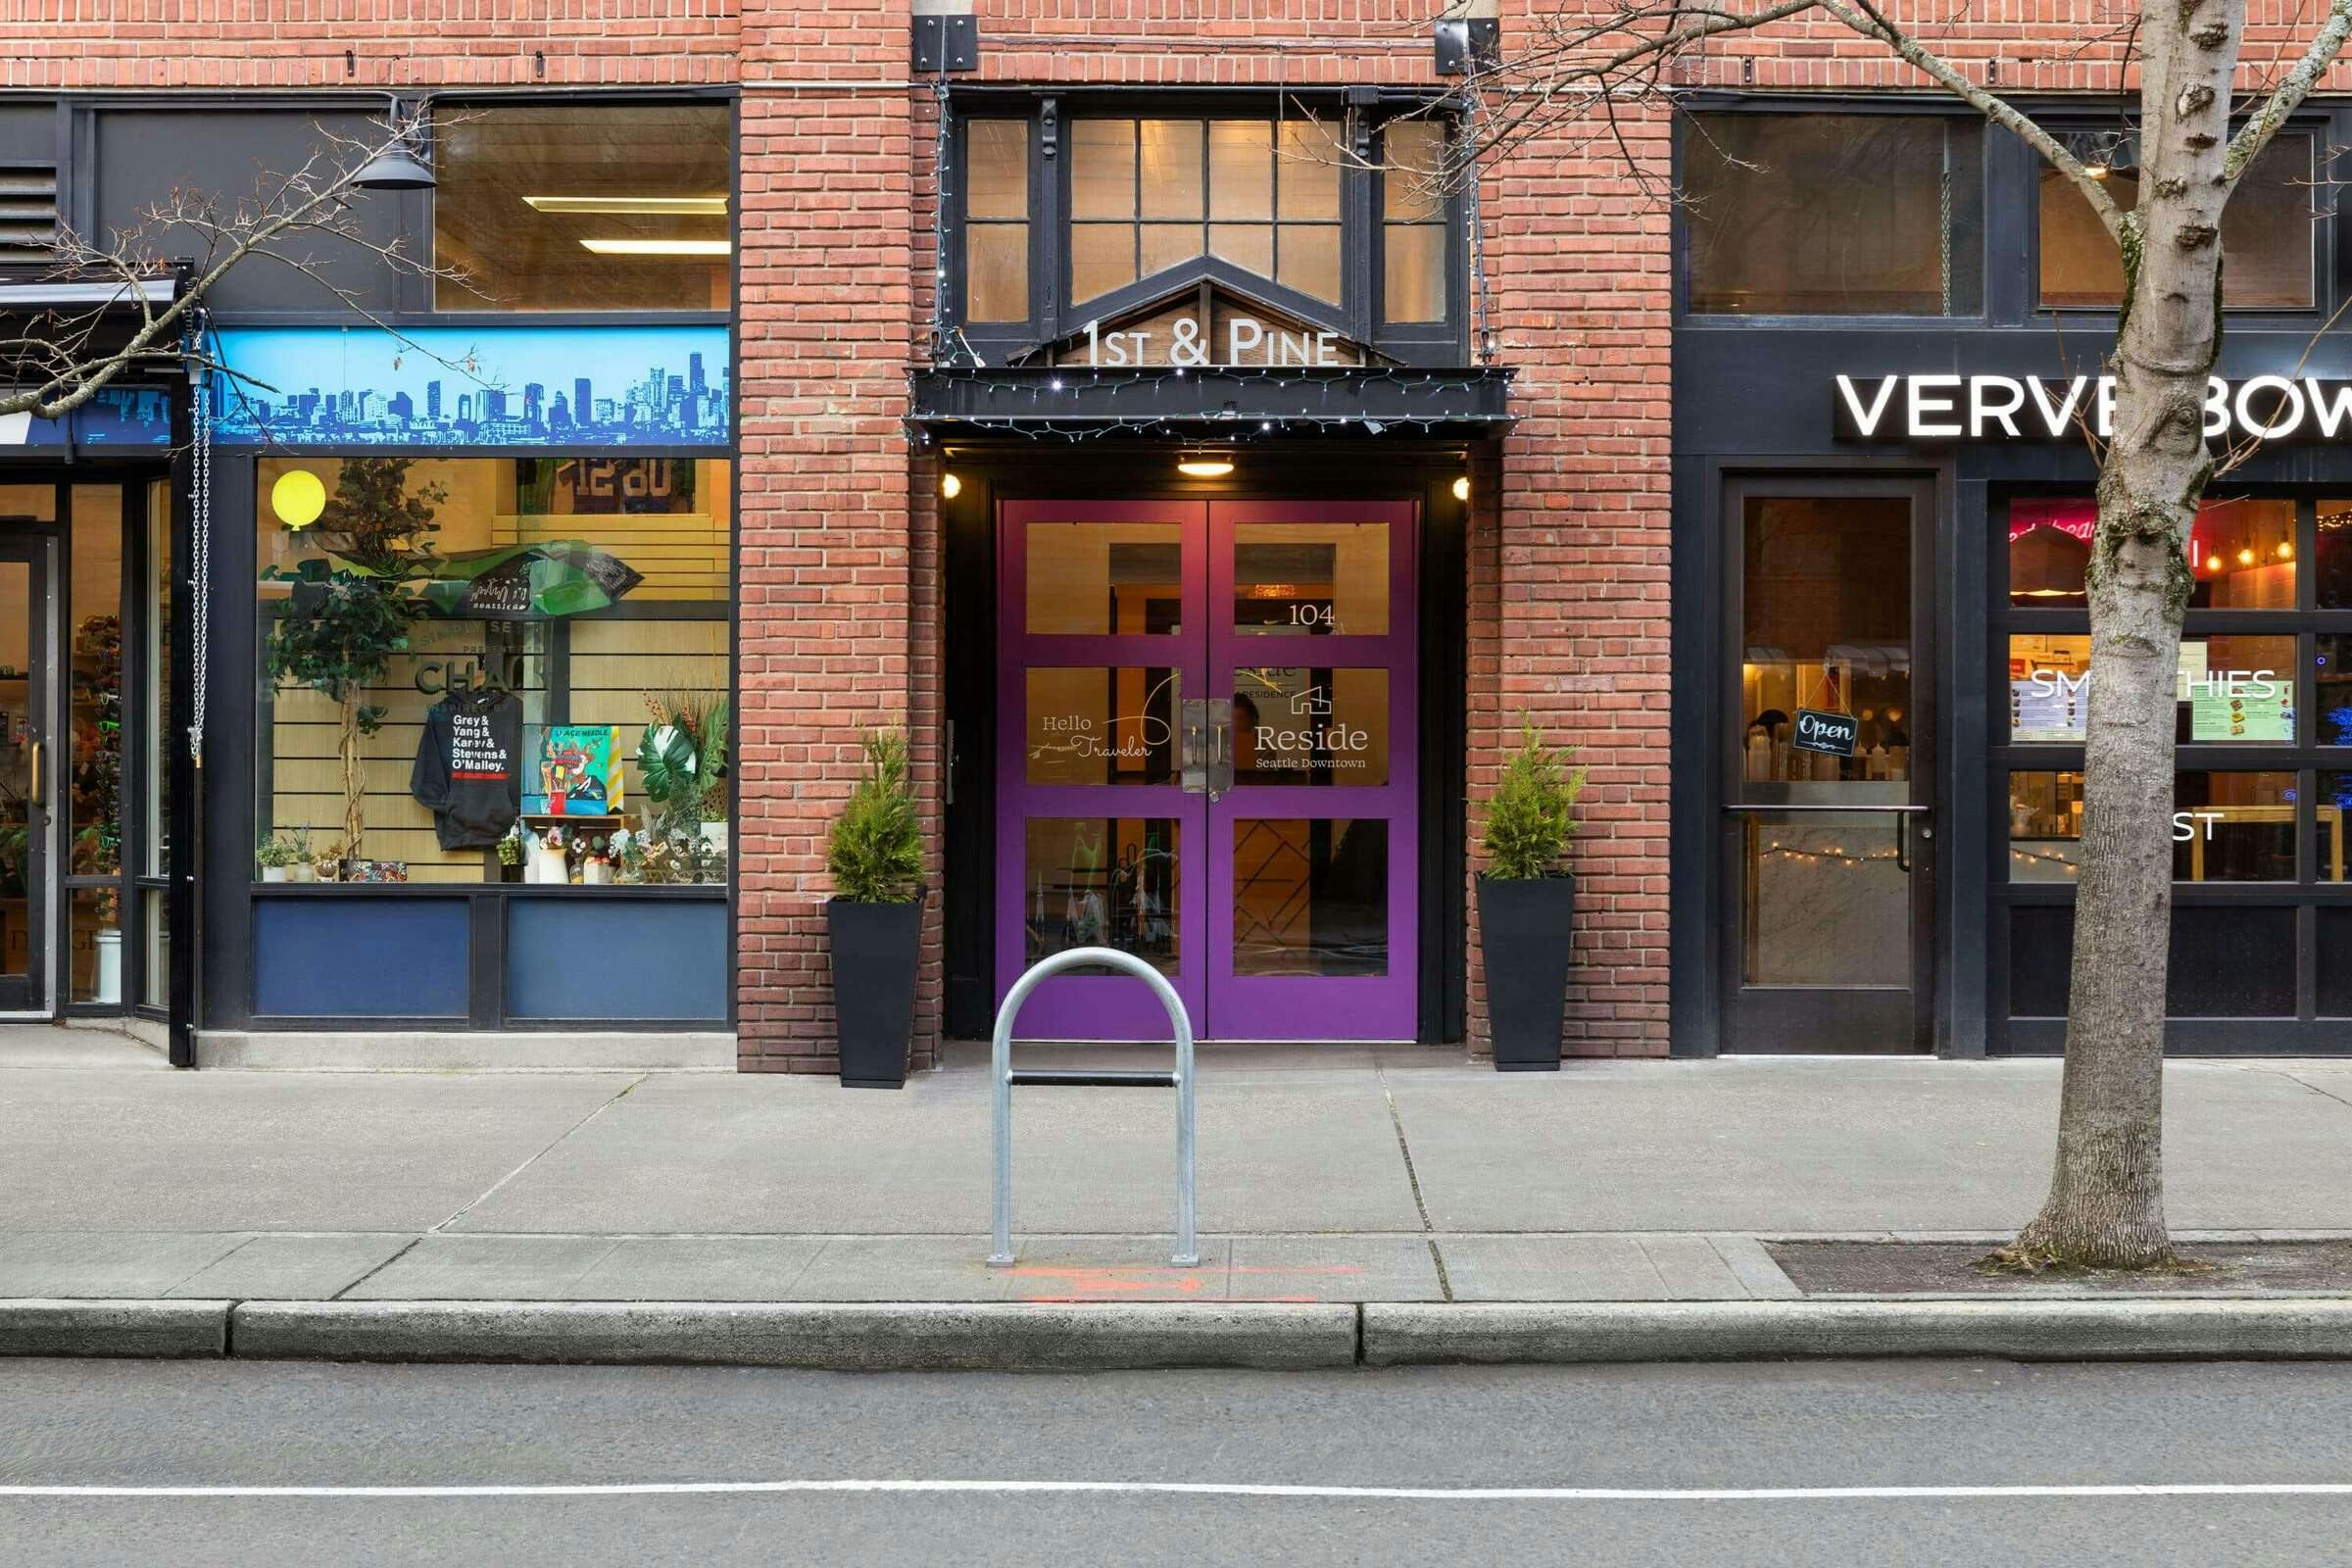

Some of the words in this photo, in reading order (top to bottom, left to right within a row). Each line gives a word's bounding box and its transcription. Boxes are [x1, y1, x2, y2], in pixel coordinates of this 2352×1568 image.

[1082, 319, 1152, 366] 1ST
[1170, 318, 1209, 366] &
[1229, 318, 1339, 366] PINE
[1289, 604, 1335, 625] 104
[2031, 669, 2276, 699] SMHIES
[1042, 714, 1093, 731] Hello
[1799, 714, 1854, 741] Open
[1070, 735, 1152, 758] Traveler
[1253, 722, 1368, 751] Reside
[1255, 758, 1298, 769] Seattle
[1301, 758, 1366, 769] Downtown
